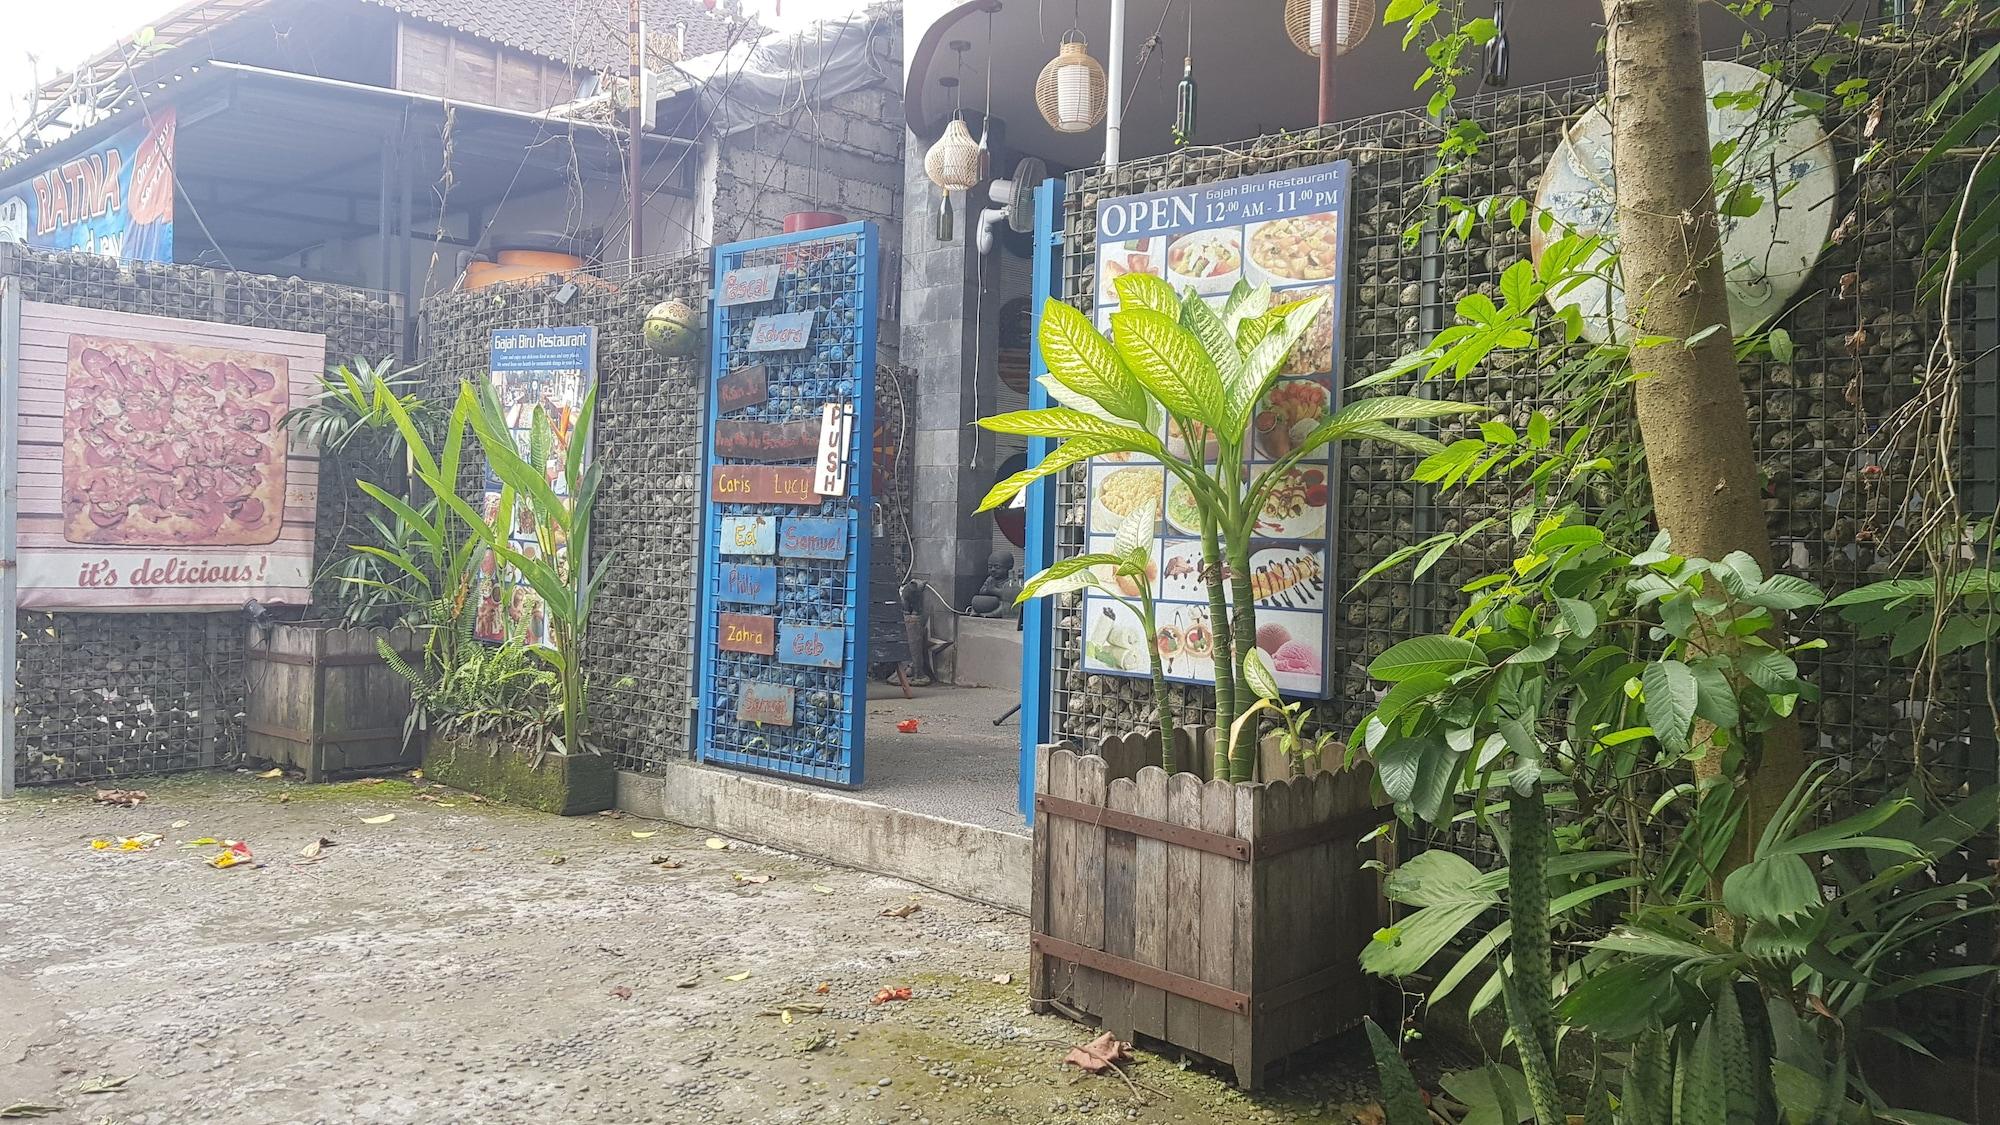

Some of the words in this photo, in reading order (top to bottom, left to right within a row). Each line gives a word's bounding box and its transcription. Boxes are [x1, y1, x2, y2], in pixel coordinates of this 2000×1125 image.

[33, 149, 122, 236] RATNA
[1206, 186, 1238, 201] Gajah
[1241, 182, 1265, 196] Biru
[1268, 169, 1339, 192] Restaurant
[1101, 192, 1199, 237] OPEN
[1241, 201, 1264, 219] AM
[1315, 189, 1338, 208] PM
[494, 335, 517, 353] Gajah
[518, 334, 536, 349] Biru
[537, 332, 587, 348] Restaurant
[824, 405, 841, 492] PUSH
[719, 474, 751, 493] Caris
[774, 474, 809, 500] Lucy
[735, 524, 757, 546] Ed
[784, 526, 842, 551] Samuel
[78, 559, 119, 587] it's
[728, 569, 761, 600] Philip
[728, 625, 762, 645] Zahra
